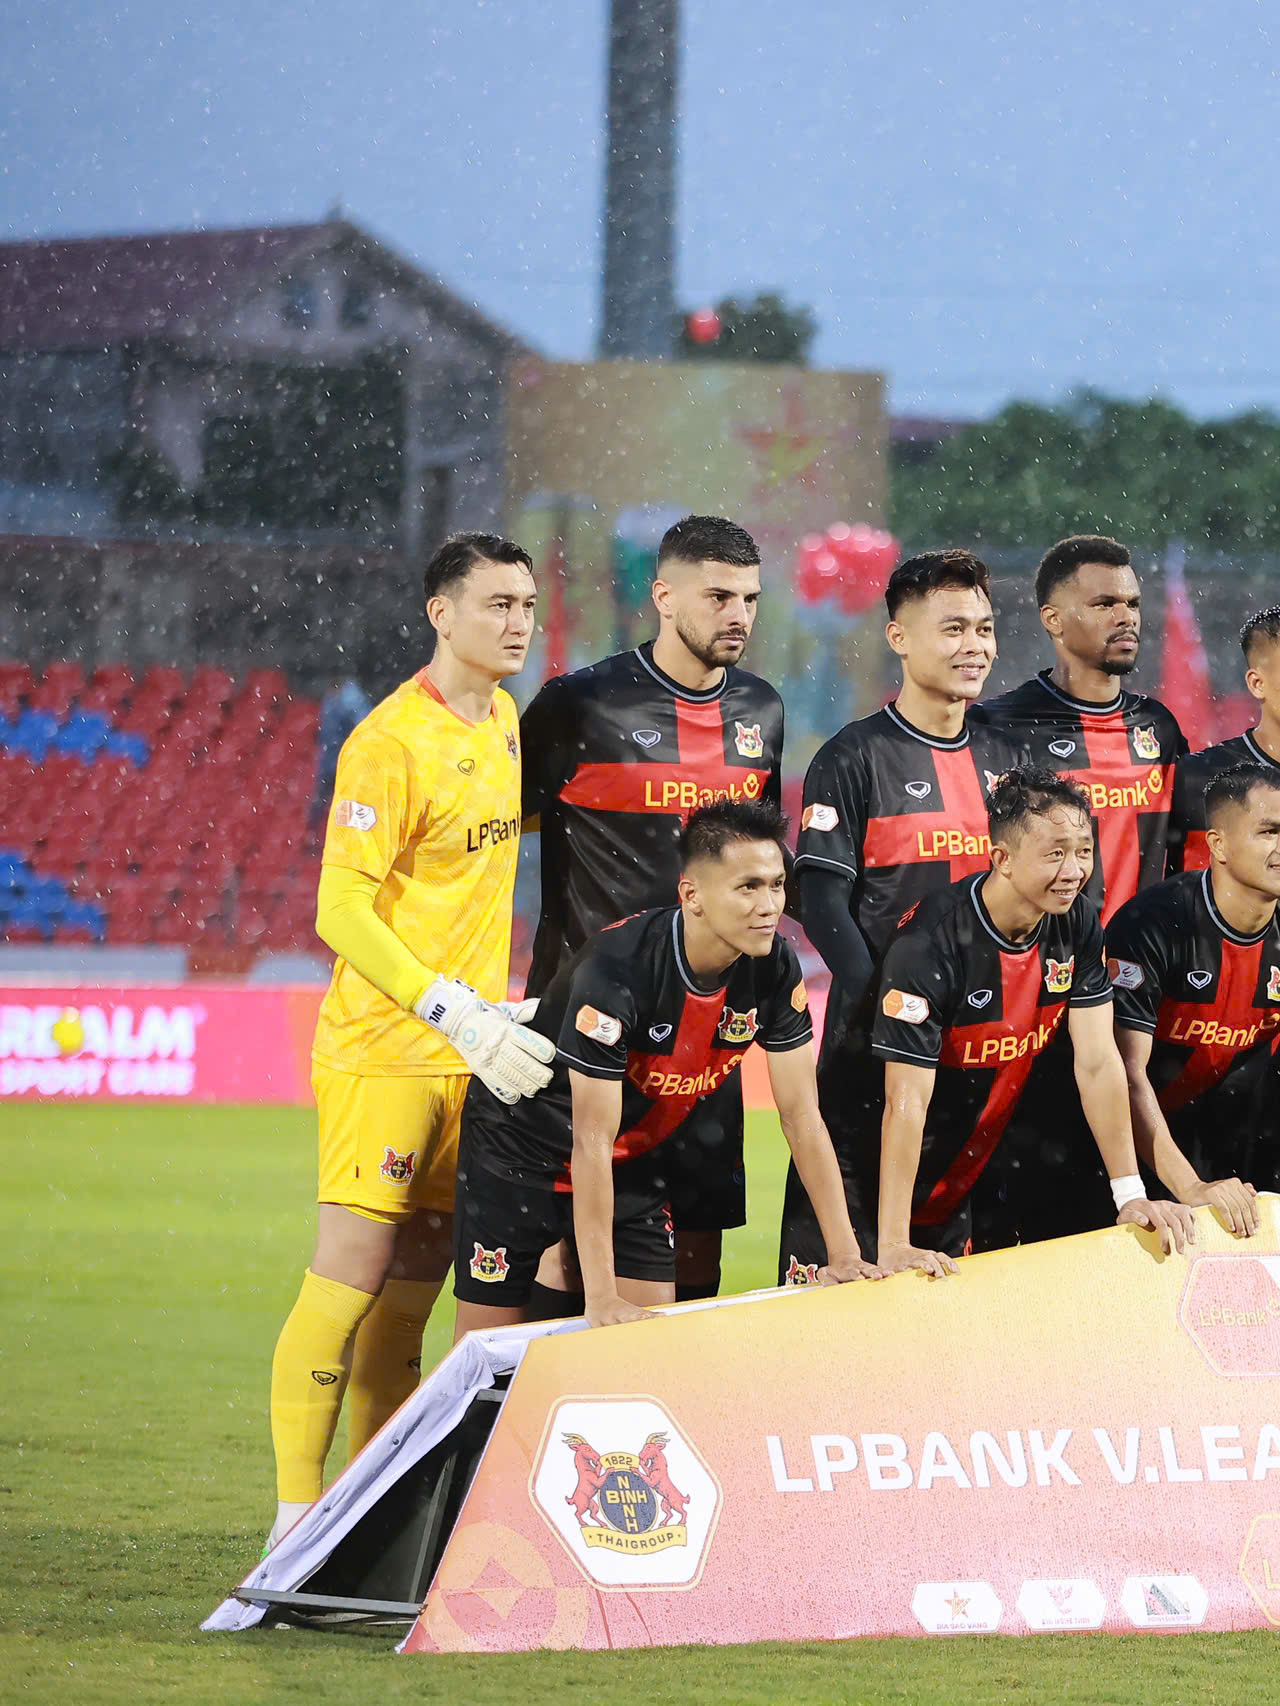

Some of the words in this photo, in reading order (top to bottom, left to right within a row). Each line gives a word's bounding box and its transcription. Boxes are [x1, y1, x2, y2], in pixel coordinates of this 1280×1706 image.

[1082, 780, 1150, 809] Bank
[917, 830, 992, 857] LPBan
[429, 1003, 446, 1023] DVL
[963, 1024, 1052, 1064] LPBank
[1169, 1017, 1260, 1047] LPBank
[1199, 1306, 1269, 1327] LPBank
[605, 1455, 633, 1466] 1822
[766, 1428, 1083, 1492] LPBANK
[605, 1489, 649, 1504] BINH
[596, 1532, 674, 1549] THAIGROUP
